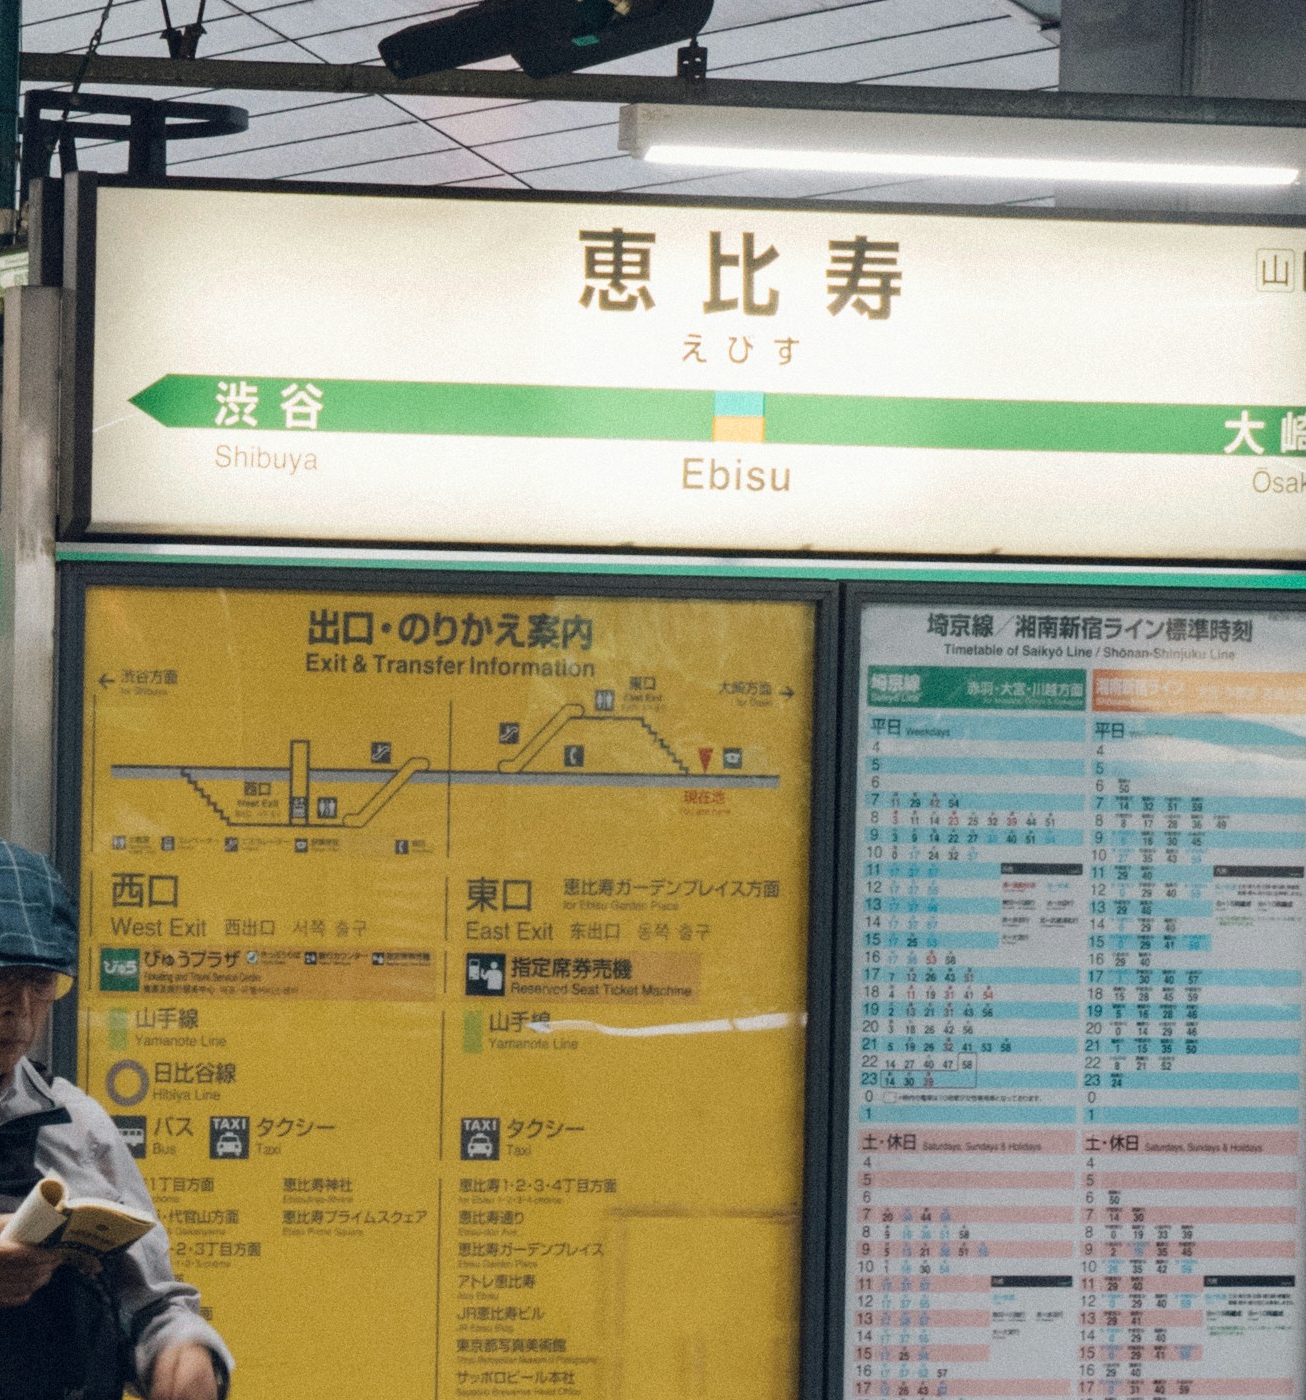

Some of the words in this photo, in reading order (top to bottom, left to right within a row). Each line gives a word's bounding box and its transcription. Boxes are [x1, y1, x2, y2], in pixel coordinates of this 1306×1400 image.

[578, 227, 903, 320] 恵比寿
[1262, 254, 1289, 286] 山
[682, 333, 800, 365] えびす
[214, 381, 323, 429] 渋谷
[215, 444, 317, 476] Shibuya
[682, 458, 790, 491] Ebisu
[308, 609, 594, 651] 出口・のりかえ案内
[306, 653, 347, 673] Exit
[353, 654, 367, 673] &
[373, 654, 464, 675] Transfer
[470, 656, 596, 678] Information
[871, 718, 901, 736] 平日
[1095, 722, 1125, 739] 平日
[871, 758, 880, 771] 5
[871, 776, 880, 788] 6
[871, 794, 880, 805] 7
[870, 811, 879, 823] 8
[870, 829, 879, 841] 9
[867, 846, 882, 858] 10
[867, 864, 880, 876] 11
[111, 872, 179, 909] 西口
[866, 881, 882, 893] 12
[466, 877, 533, 912] 東口
[866, 898, 881, 910] 13
[110, 917, 163, 938] West
[170, 917, 207, 938] Exit
[224, 918, 276, 938] 西出口
[866, 916, 881, 927] 14
[465, 921, 511, 941] East
[517, 922, 554, 941] Exit
[865, 933, 881, 945] 15
[864, 950, 880, 962] 16
[511, 957, 633, 981] 指定席券売機
[864, 968, 880, 980] 17
[864, 985, 879, 998] 18
[863, 1003, 879, 1015] 19
[136, 1006, 199, 1030] 山手線
[862, 1020, 879, 1032] 20
[1086, 1022, 1102, 1035] 20
[862, 1038, 877, 1050] 21
[861, 1055, 878, 1067] 22
[1084, 1056, 1101, 1069] 22
[153, 1061, 237, 1085] 日比谷線
[861, 1072, 878, 1085] 23
[1084, 1074, 1101, 1087] 23
[153, 1116, 195, 1137] バス
[212, 1118, 247, 1131] TAXI
[256, 1116, 336, 1138] タクシー
[463, 1119, 497, 1132] TAXI
[506, 1118, 586, 1139] タクシー
[152, 1142, 177, 1155] Bus
[862, 1133, 916, 1151] 土・休日
[1086, 1134, 1139, 1151] 土・休日
[146, 1176, 215, 1194] 1丁目方面
[856, 1347, 872, 1359] 15
[856, 1382, 871, 1394] 17
